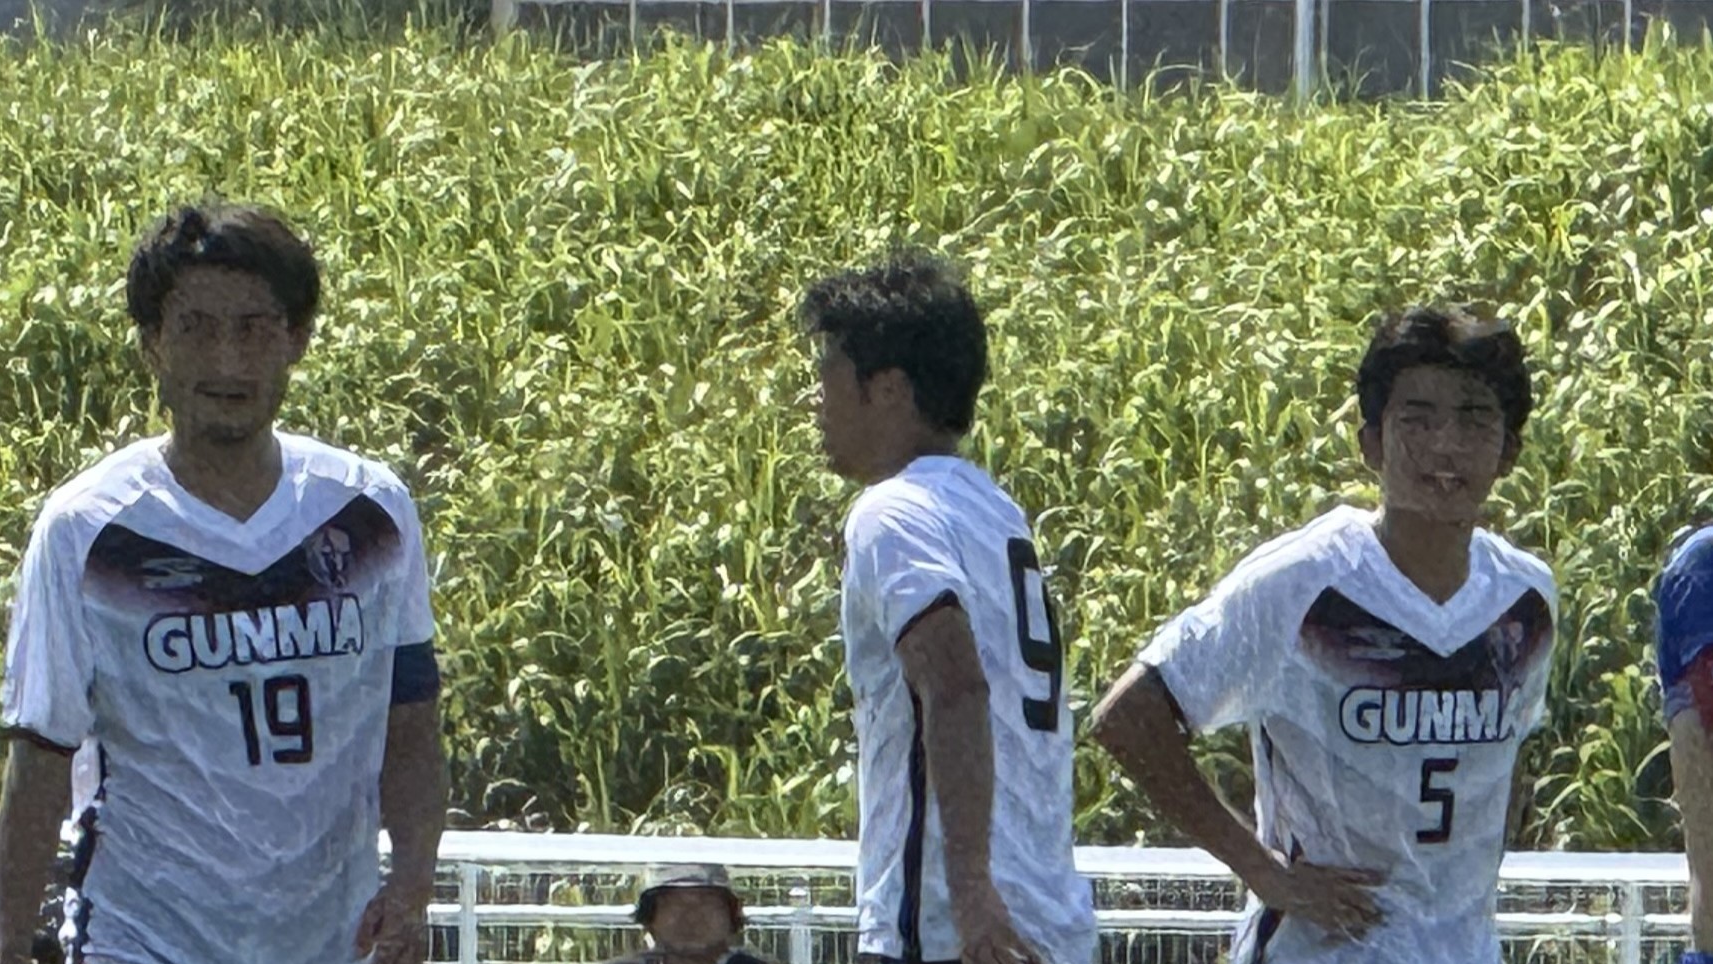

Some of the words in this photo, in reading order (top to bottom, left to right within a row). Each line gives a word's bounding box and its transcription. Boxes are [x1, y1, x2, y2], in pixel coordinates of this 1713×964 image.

[144, 593, 364, 673] GUNMA
[1007, 537, 1062, 732] 9
[230, 673, 312, 766] 19
[1340, 686, 1520, 745] GUNMA
[1416, 758, 1459, 843] 5
